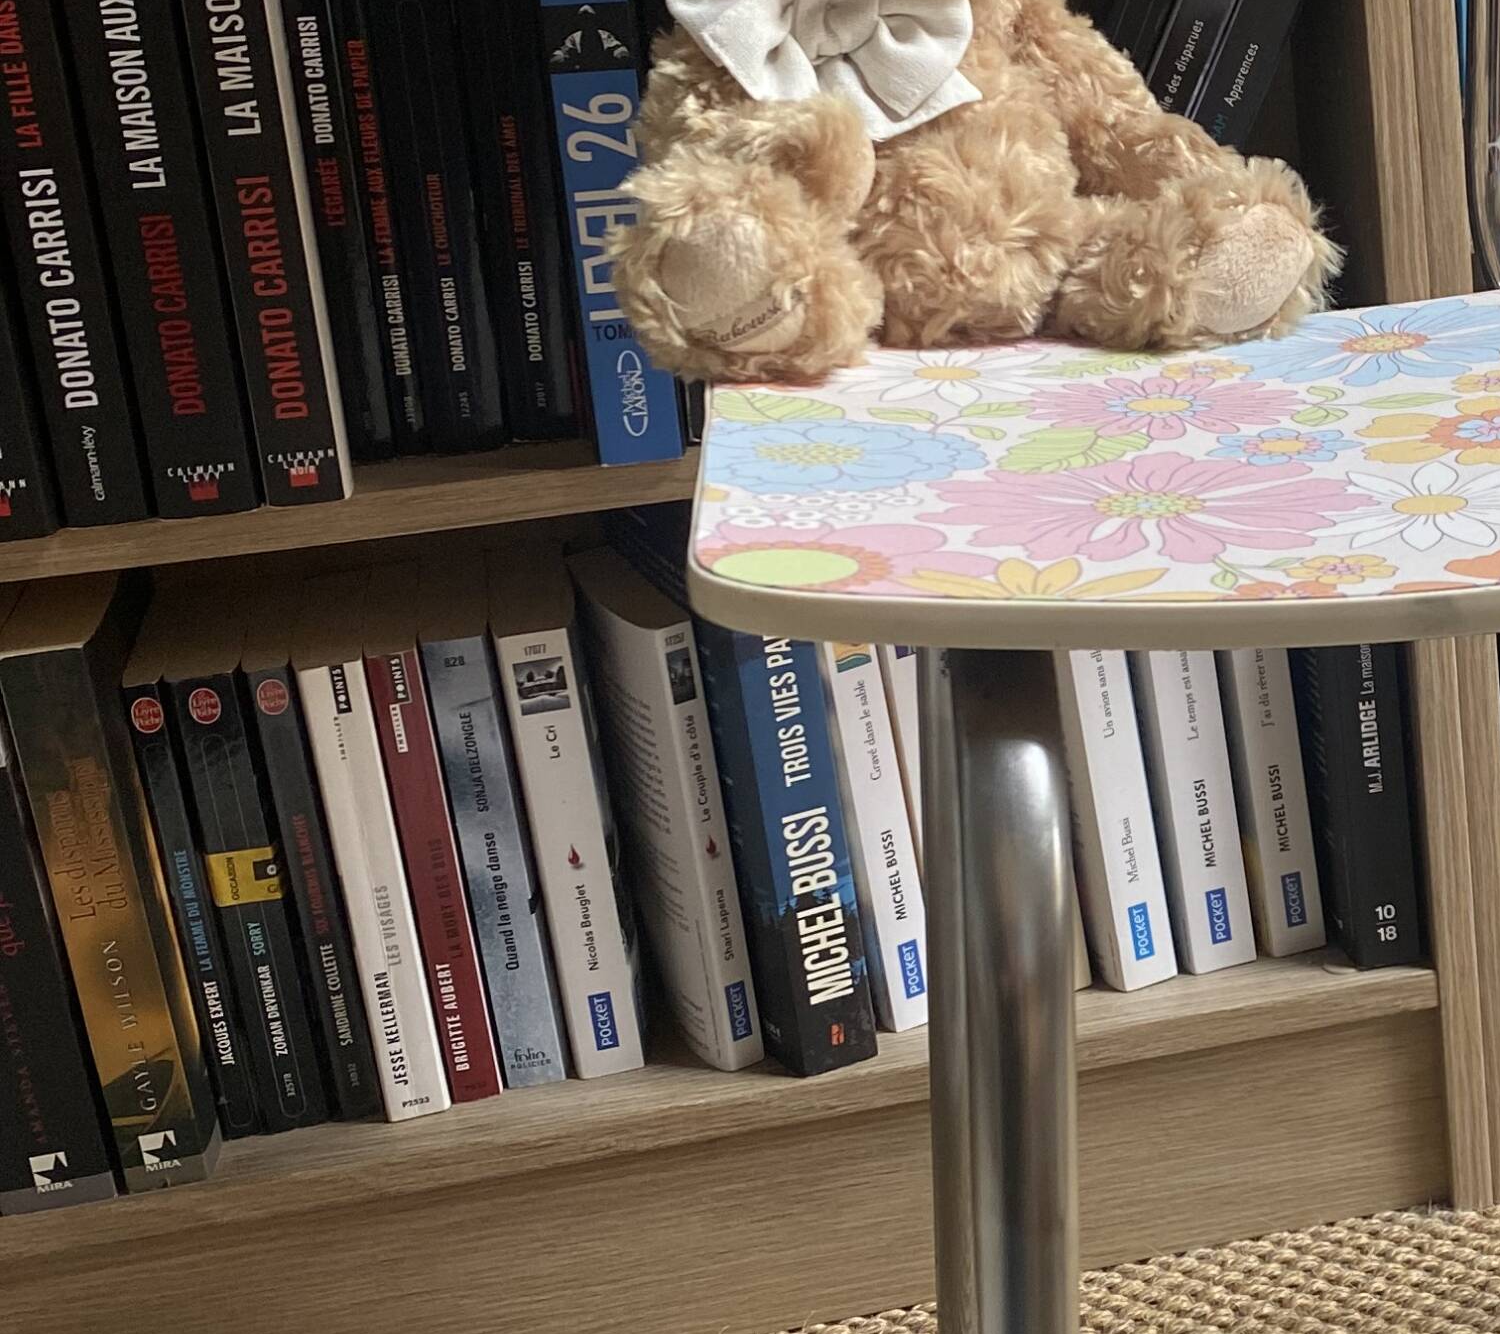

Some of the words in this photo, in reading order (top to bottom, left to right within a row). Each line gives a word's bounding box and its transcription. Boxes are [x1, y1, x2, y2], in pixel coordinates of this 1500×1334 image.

[297, 16, 325, 79] CARRISI
[6, 61, 36, 117] FILLE
[1223, 43, 1260, 107] Apparences
[108, 49, 160, 151] MAISON
[223, 99, 262, 137] LA
[305, 83, 335, 144] DONATO
[15, 123, 43, 148] LA
[560, 92, 638, 163] 26
[129, 155, 168, 189] LA
[19, 167, 76, 288] CARRISI
[236, 176, 289, 298] CARRISI
[138, 214, 188, 313] CARRISI
[518, 261, 540, 310] CARRISI
[382, 274, 405, 324] CARRISI
[441, 277, 461, 324] CARRISI
[46, 297, 99, 409] DONATO
[443, 323, 467, 372] DONATO
[524, 312, 543, 363] DONATO
[157, 320, 206, 415] DONATO
[259, 308, 309, 419] DONATO
[331, 667, 349, 709] POINTS
[390, 658, 407, 699] POINTS
[769, 671, 802, 722] VIES
[1360, 681, 1374, 695] La
[459, 711, 482, 774] DELZONGLE
[545, 724, 559, 743] Cri
[549, 746, 561, 760] Le
[1103, 721, 1116, 739] Un
[1187, 726, 1200, 741] Le
[1358, 700, 1382, 768] ARLIDGE
[778, 723, 811, 787] TROIS
[473, 773, 490, 813] SONJA
[693, 764, 708, 806] Couple
[1193, 779, 1210, 816] BUSSI
[1266, 764, 1284, 801] BUSSI
[880, 829, 900, 870] BUSSI
[1199, 818, 1217, 868] MICHEL
[1274, 803, 1291, 852] MICHEL
[483, 832, 501, 872] danse
[782, 806, 838, 896] BUSSI
[187, 901, 200, 918] DU
[374, 885, 397, 944] VISAGES
[492, 874, 509, 913] neige
[575, 883, 592, 929] Beuglet
[715, 889, 730, 931] Lapena
[884, 872, 908, 921] MICHEL
[1375, 904, 1396, 921] 10
[247, 922, 266, 956] SORRY
[497, 913, 510, 929] la
[1377, 925, 1398, 942] 18
[387, 946, 402, 966] LES
[499, 931, 519, 971] Quand
[583, 930, 599, 971] Nicolas
[720, 932, 735, 961] Shari
[796, 893, 854, 1005] MICHEL
[203, 980, 225, 1018] EXPERT
[374, 970, 403, 1045] KELLERMAN
[435, 962, 458, 1011] AUBERT
[268, 1018, 289, 1057] ZORAN
[330, 991, 353, 1046] SANDRINE
[213, 1020, 235, 1066] JACQUES
[387, 1047, 408, 1085] JESSE
[444, 1018, 471, 1071] BRIGITTE
